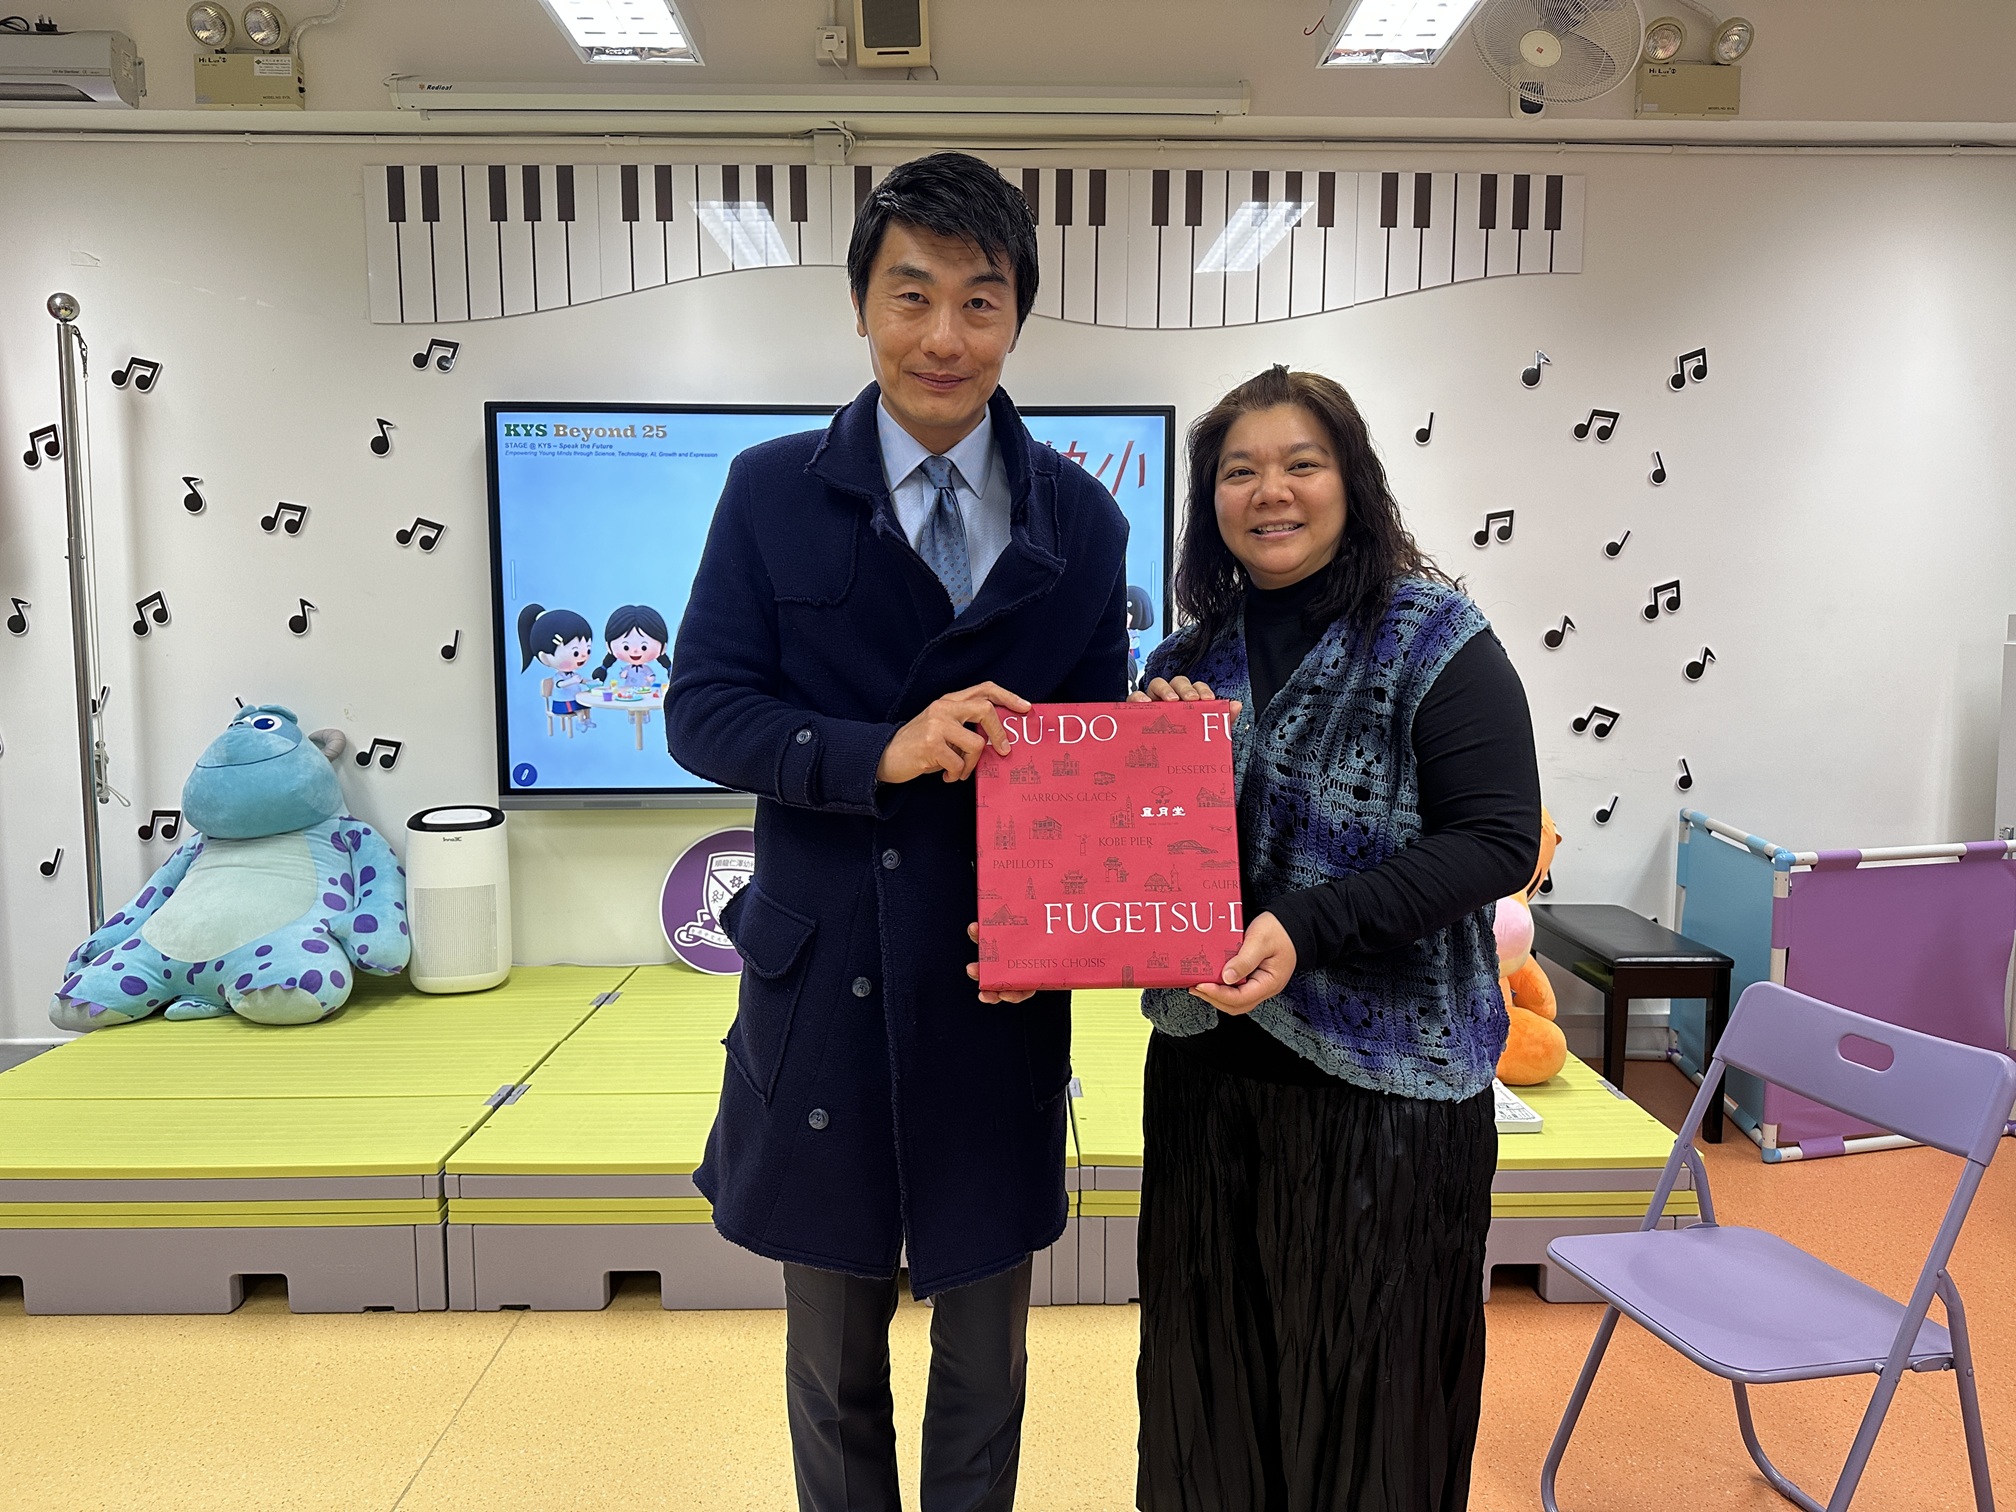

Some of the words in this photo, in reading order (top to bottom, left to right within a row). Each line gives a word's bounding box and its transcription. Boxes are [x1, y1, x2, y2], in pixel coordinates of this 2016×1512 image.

[504, 423, 548, 437] KYS
[553, 424, 637, 442] Beyond
[642, 424, 668, 439] 25
[529, 442, 537, 450] @
[559, 442, 579, 451] Speak
[592, 442, 614, 450] Future
[504, 449, 538, 457] Empowering
[539, 449, 556, 457] Young
[573, 449, 594, 458] through
[594, 450, 617, 458] Science,
[618, 450, 649, 459] Technology,
[689, 451, 719, 459] Expression
[986, 714, 1118, 745] SU-DO
[1166, 765, 1217, 775] DESSERTS
[1021, 793, 1074, 802] MARRONS
[1098, 837, 1128, 847] KOBE
[1129, 836, 1154, 846] PIER
[993, 859, 1054, 869] PAPILLOTES
[1007, 959, 1058, 969] DESSERTS
[1062, 957, 1106, 968] CHOISIS
